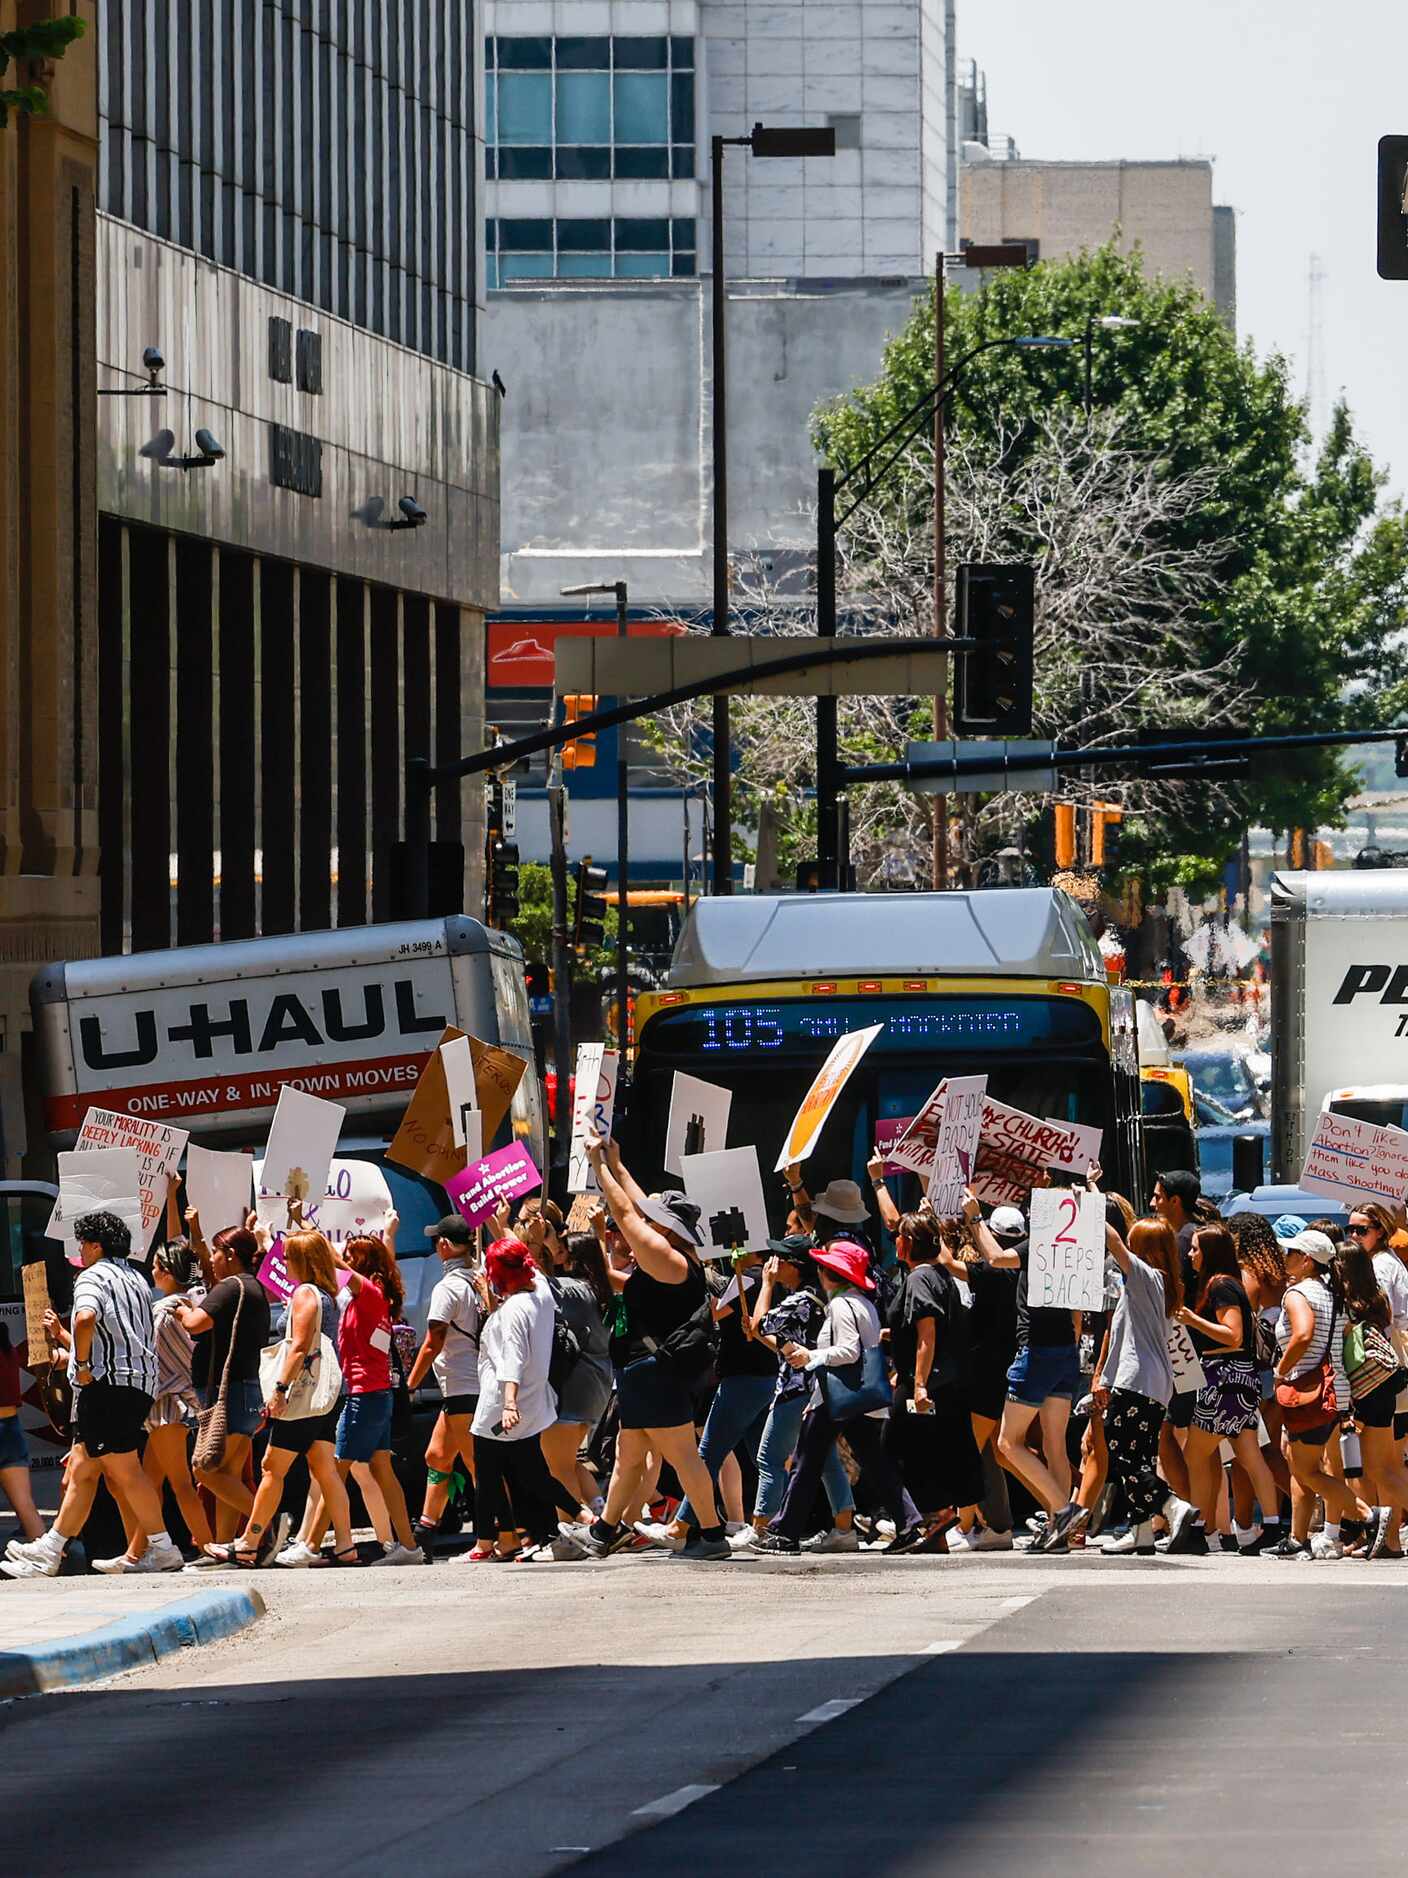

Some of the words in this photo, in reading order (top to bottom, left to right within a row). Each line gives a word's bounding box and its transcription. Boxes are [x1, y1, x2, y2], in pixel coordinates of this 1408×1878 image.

[504, 786, 514, 800] ONE
[412, 941, 433, 953] 3499
[435, 940, 443, 950] A
[80, 980, 447, 1071] U-HAUL
[702, 1008, 784, 1048] 105
[127, 1088, 220, 1113] ONE-WAY
[226, 1086, 241, 1102] &
[250, 1074, 340, 1100] IN-TOWN
[346, 1064, 419, 1089] MOVES
[81, 1124, 119, 1145] DEEPLY
[120, 1134, 161, 1158] LACKING
[164, 1146, 178, 1161] IF
[94, 1111, 116, 1128] YOUR
[114, 1115, 160, 1138] MORALITY
[160, 1128, 173, 1143] IS
[1321, 1115, 1361, 1138] Don't
[1372, 1129, 1400, 1147] like
[1314, 1133, 1376, 1158] Abortion?
[142, 1157, 153, 1172] IS
[1308, 1163, 1340, 1181] Mass
[1312, 1149, 1339, 1165] them
[1345, 1155, 1367, 1170] like
[1371, 1163, 1391, 1180] you
[459, 1181, 483, 1205] Fund
[482, 1159, 528, 1188] Abortion
[469, 1189, 495, 1214] Build
[493, 1172, 528, 1196] Power
[1056, 1198, 1077, 1244] 2
[270, 1256, 288, 1275] Fun
[1035, 1243, 1095, 1272] STEPS
[1042, 1272, 1091, 1306] BACK
